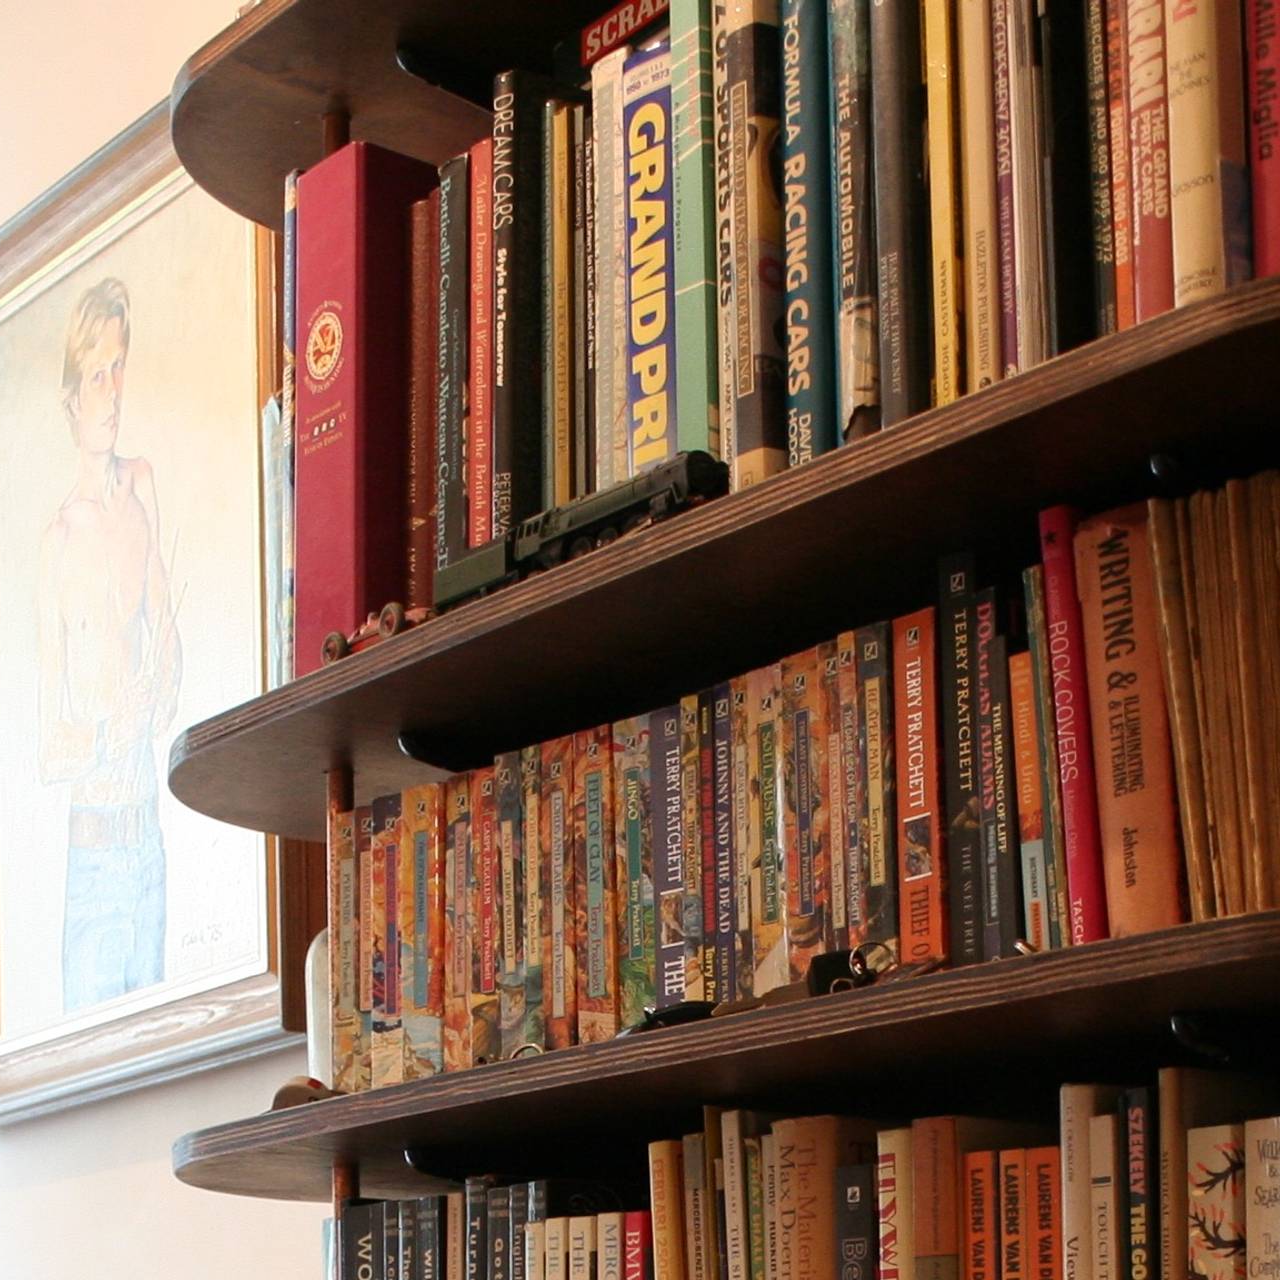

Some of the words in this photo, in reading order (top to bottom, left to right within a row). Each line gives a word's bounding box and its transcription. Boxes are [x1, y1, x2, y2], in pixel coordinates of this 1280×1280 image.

[586, 0, 669, 57] SCRA
[783, 16, 801, 145] FORMULA
[838, 74, 851, 120] THE
[492, 93, 514, 170] DREAM
[1254, 68, 1277, 161] Miglia
[717, 87, 733, 212] SPORTS
[493, 175, 512, 229] CARS
[629, 103, 666, 344] GRAND
[784, 152, 807, 289] RACING
[839, 131, 855, 285] AUTOMOBILE
[471, 232, 488, 296] Drawings
[496, 248, 508, 278] Style
[718, 220, 734, 307] CARS
[475, 301, 488, 322] and
[496, 282, 508, 306] for
[475, 327, 489, 416] Watercolours
[496, 312, 506, 386] Tomorrow
[787, 297, 809, 396] CARS
[633, 346, 668, 462] PRI
[476, 435, 489, 458] the
[476, 463, 489, 509] British
[1097, 529, 1136, 662] WRITING
[1048, 621, 1070, 683] ROCK
[905, 657, 922, 708] TERRY
[763, 732, 774, 773] SOUL
[906, 712, 924, 809] PRATCHETT
[1052, 689, 1077, 783] COVERS
[1109, 714, 1129, 798] LETTERING
[1124, 696, 1145, 793] ILLUMINATING
[666, 747, 680, 792] TERRY
[716, 739, 728, 804] JOHNNY
[869, 747, 879, 780] MAN
[588, 779, 600, 817] FEET
[628, 779, 638, 820] JINGO
[764, 778, 774, 827] MUSIC
[870, 806, 881, 831] Terry
[588, 821, 600, 840] OF
[667, 796, 682, 882] PRATCHETT
[717, 811, 729, 845] AND
[763, 838, 775, 863] Terry
[588, 844, 601, 885] CLAY
[718, 849, 730, 885] THE
[871, 833, 882, 880] Pratchett
[1122, 827, 1138, 888] Johnston
[629, 879, 640, 900] Terry
[718, 887, 730, 934] DEAD
[765, 865, 776, 912] Pratchett
[910, 886, 929, 936] THIEF
[590, 902, 601, 934] Terry
[631, 903, 640, 947] Pratchett
[590, 938, 602, 993] Pratchett
[664, 957, 685, 995] THE
[779, 1144, 795, 1202] Max
[797, 1139, 817, 1202] The
[1128, 1106, 1144, 1194] SZEKELY
[970, 1168, 986, 1233] LAURENS
[1037, 1163, 1052, 1229] LAURENS
[1039, 1234, 1052, 1264] VAN
[1131, 1204, 1146, 1244] THE
[971, 1240, 986, 1267] VAN
